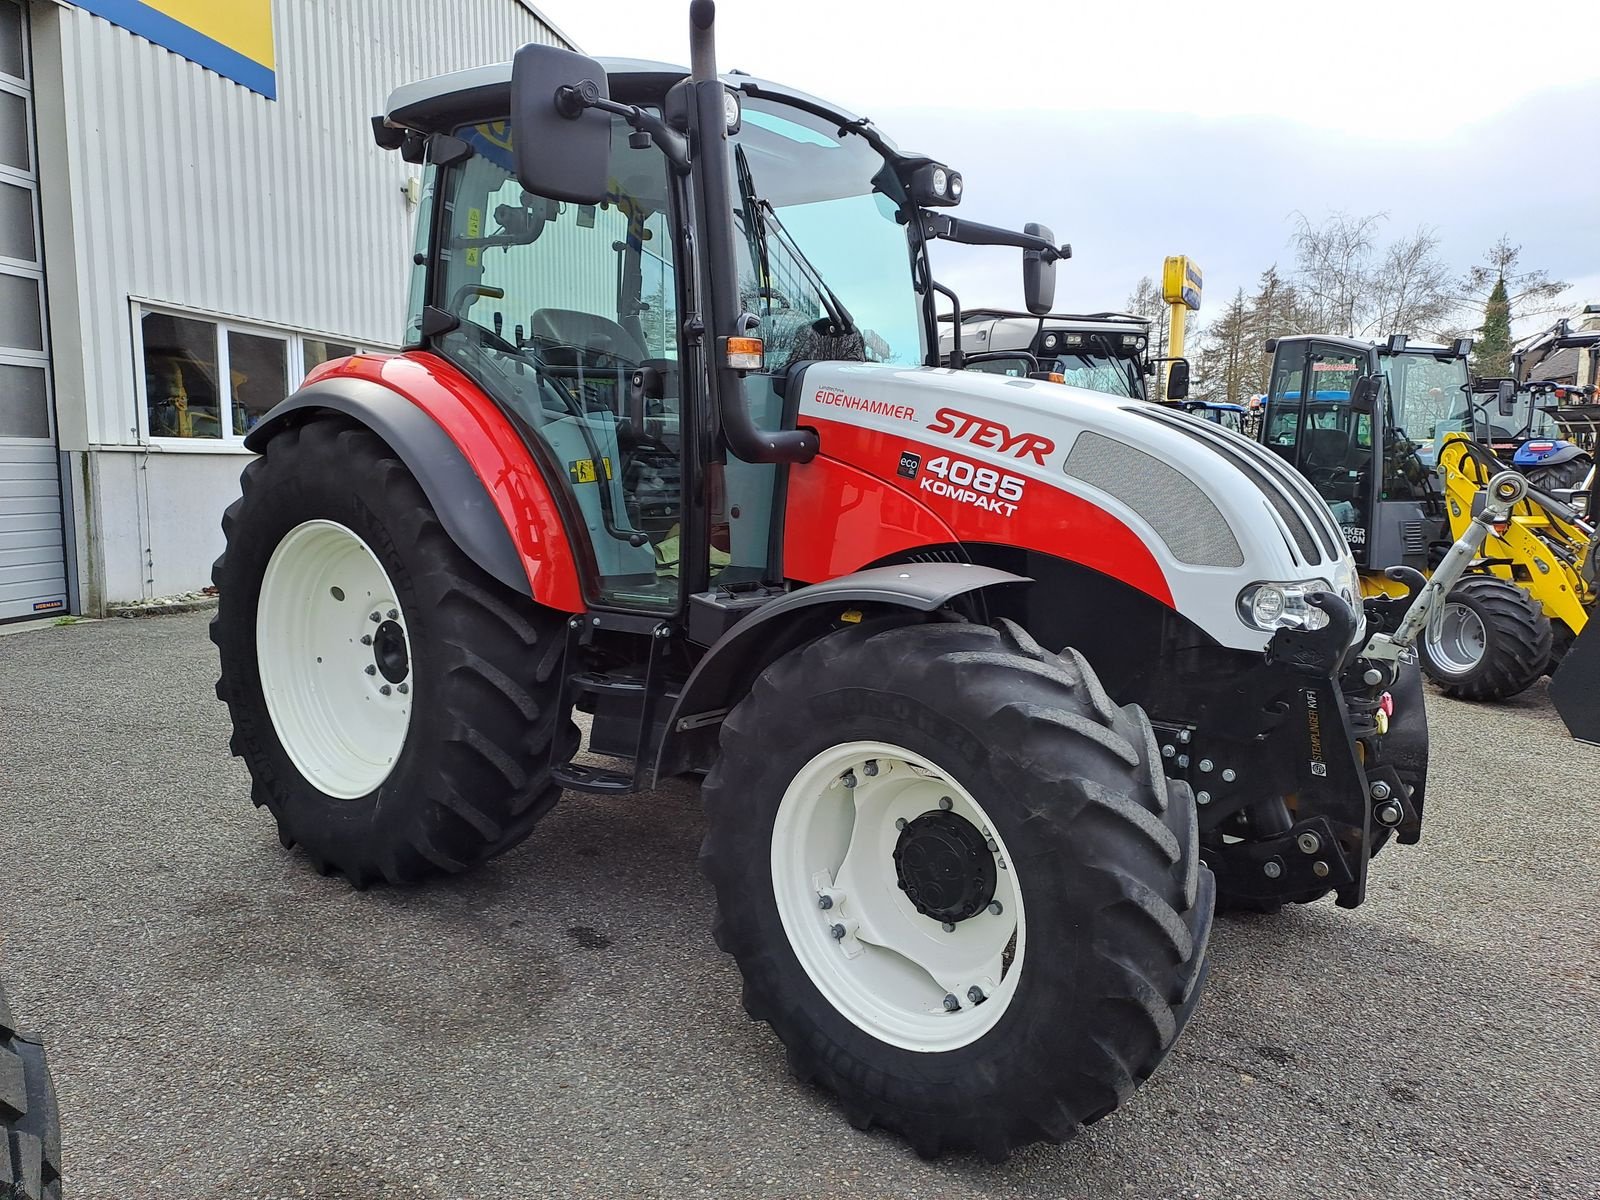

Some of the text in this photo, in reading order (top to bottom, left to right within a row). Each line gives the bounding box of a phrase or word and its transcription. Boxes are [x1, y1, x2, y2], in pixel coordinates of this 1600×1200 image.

[815, 390, 915, 421] EIDENHAMMER
[926, 407, 1056, 466] STEYR
[900, 457, 917, 469] eco
[926, 456, 1026, 502] 4085
[920, 477, 1018, 517] KOMPAKT
[1342, 526, 1366, 537] CKER
